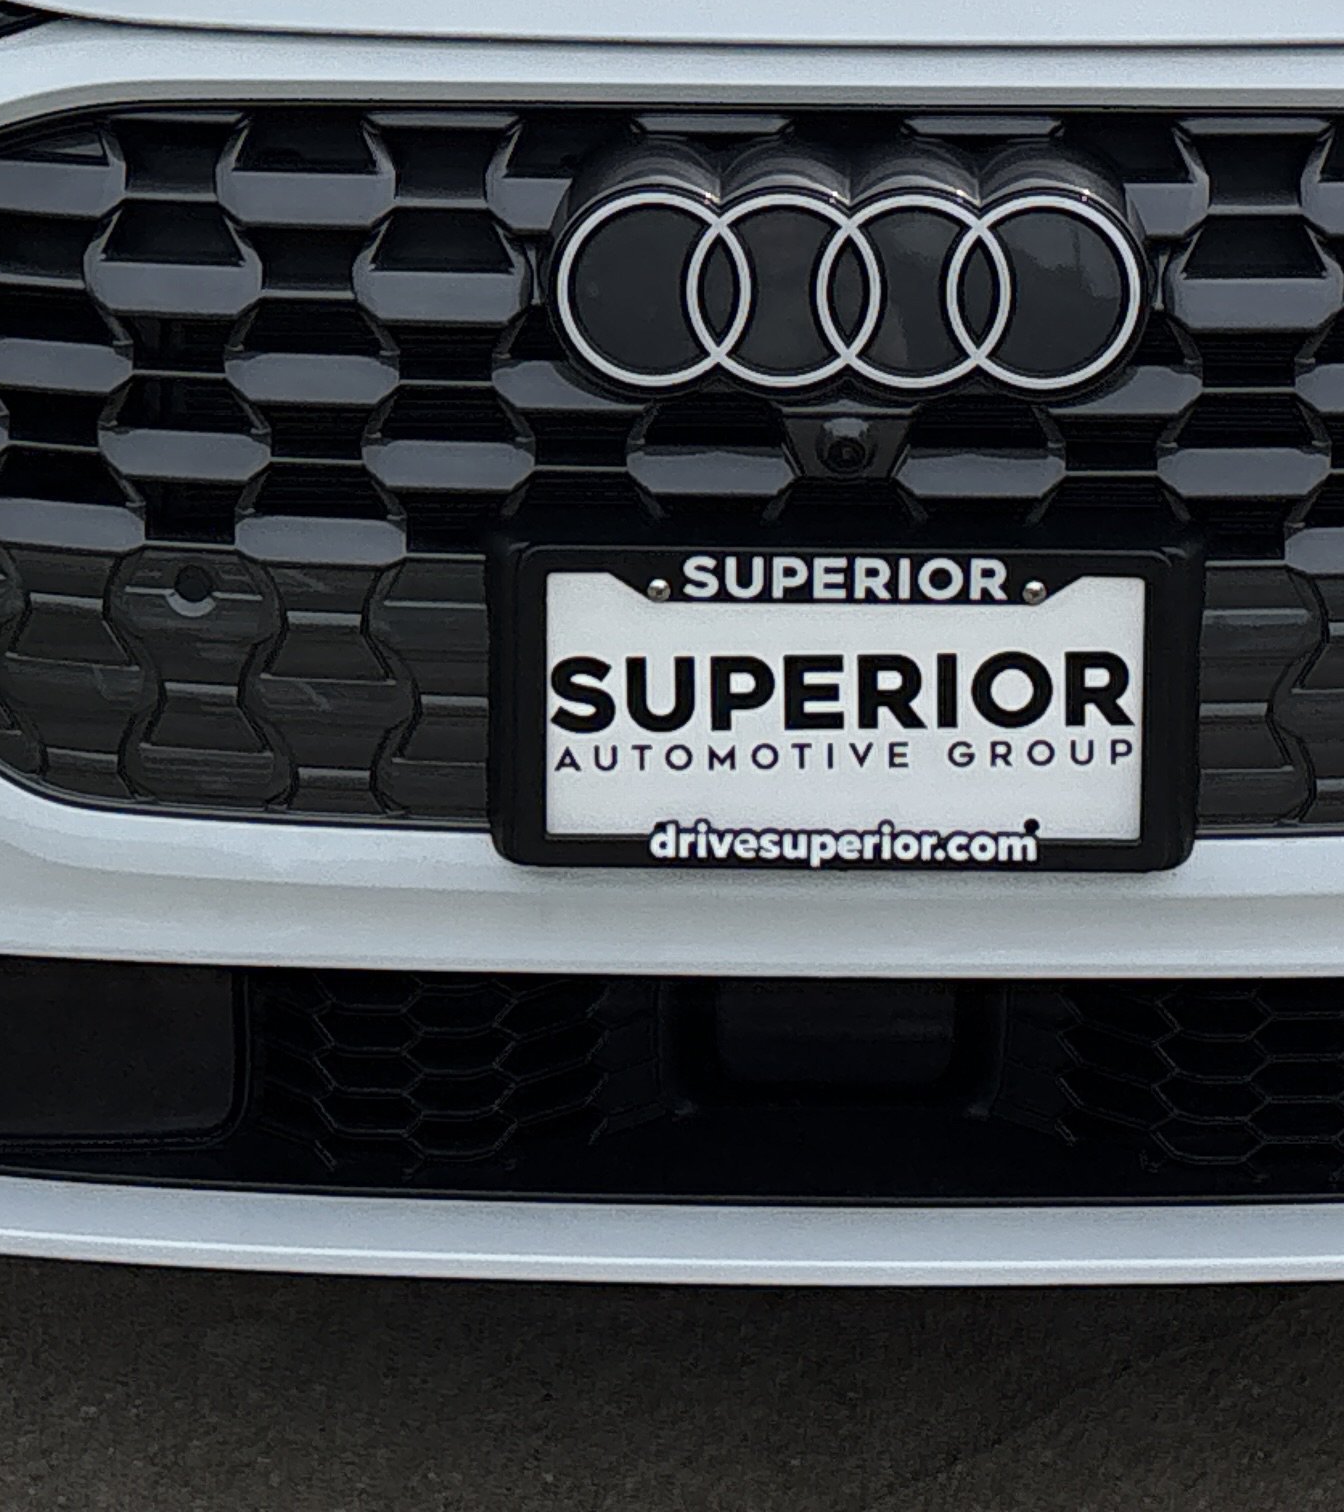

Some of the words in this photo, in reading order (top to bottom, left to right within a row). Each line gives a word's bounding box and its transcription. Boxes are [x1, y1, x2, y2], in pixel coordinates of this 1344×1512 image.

[682, 555, 1009, 601] SUPERIOR
[550, 650, 1135, 734] SUPERIOR
[554, 741, 910, 772] AUTOMOTIVE
[947, 738, 1134, 768] GROUP
[650, 821, 1038, 868] drivesuperior.com
